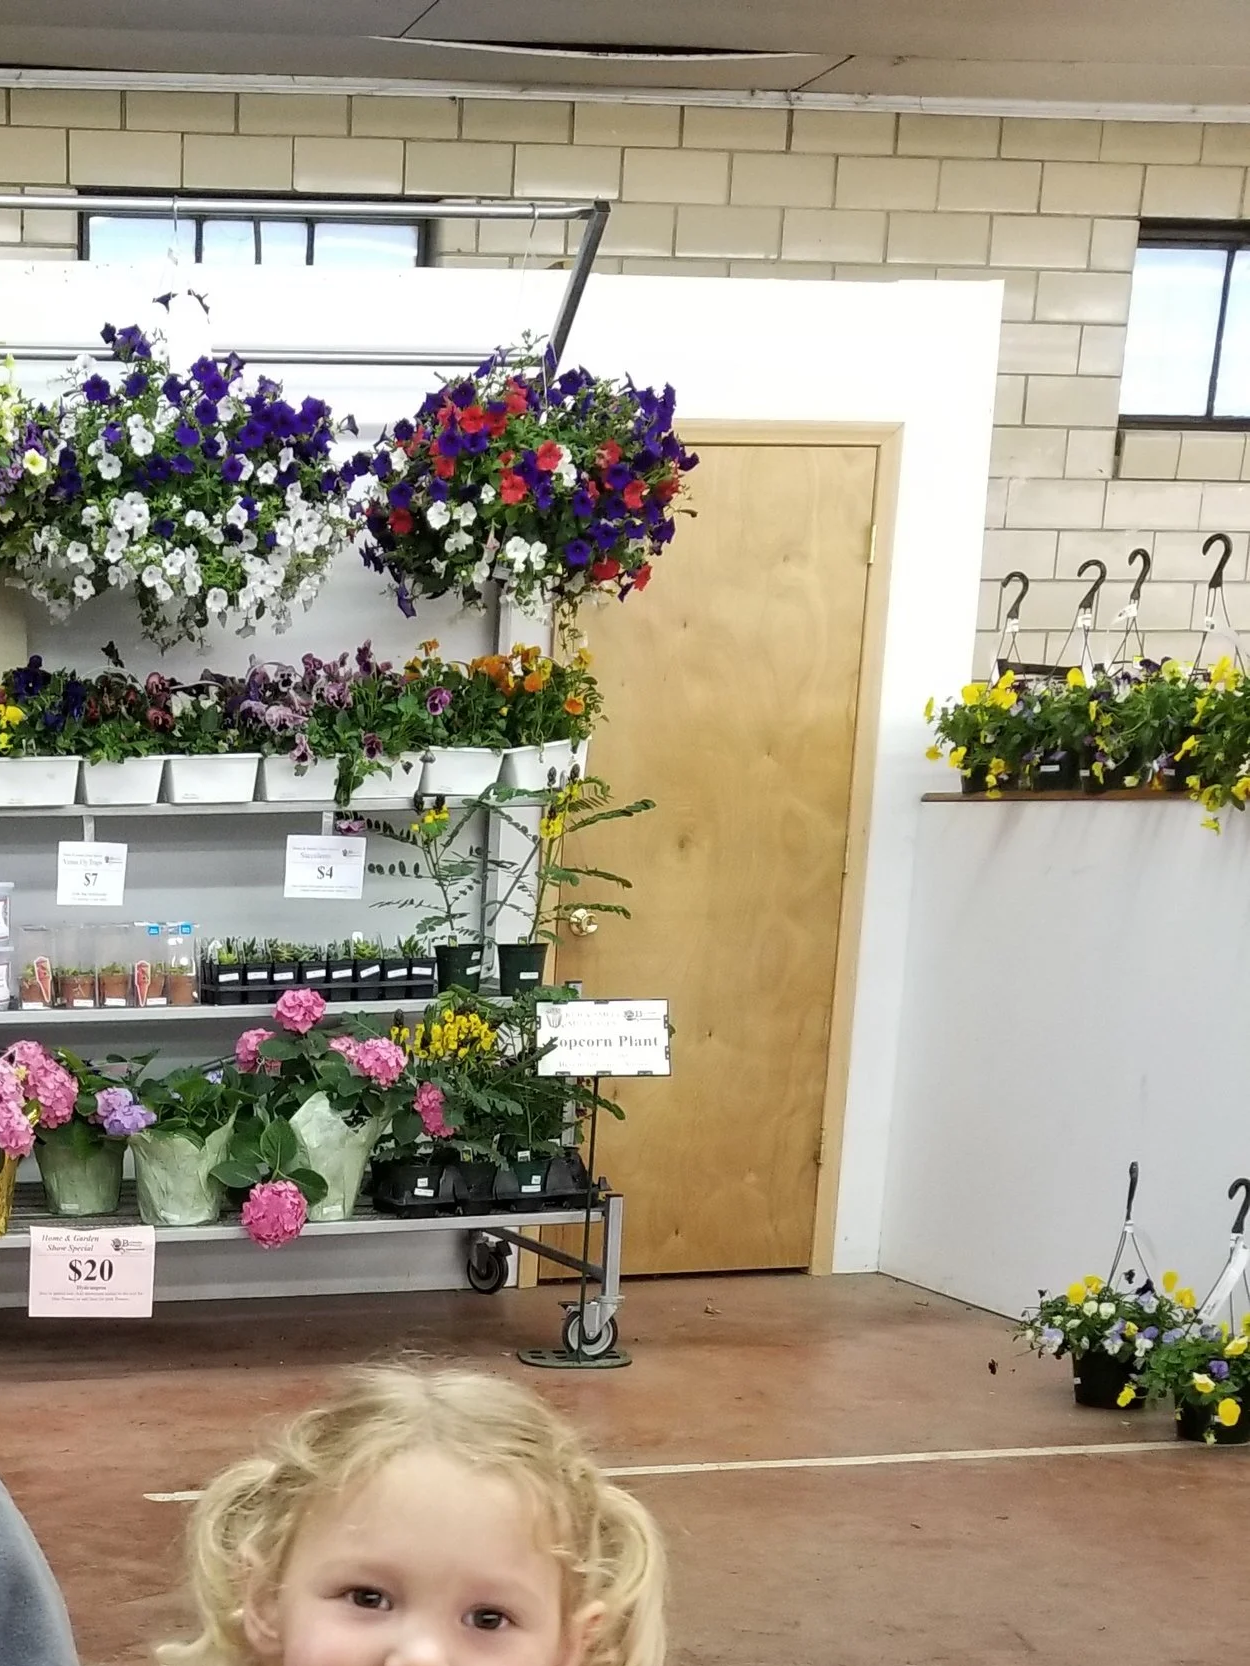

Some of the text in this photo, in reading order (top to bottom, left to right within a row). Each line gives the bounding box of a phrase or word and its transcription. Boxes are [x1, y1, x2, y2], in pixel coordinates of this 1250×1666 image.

[83, 872, 99, 887] $7
[316, 865, 334, 880] $4
[557, 1035, 658, 1050] opcorn Plant
[41, 1234, 100, 1242] Home & Garden
[46, 1244, 94, 1254] Show Special
[68, 1258, 114, 1283] $20
